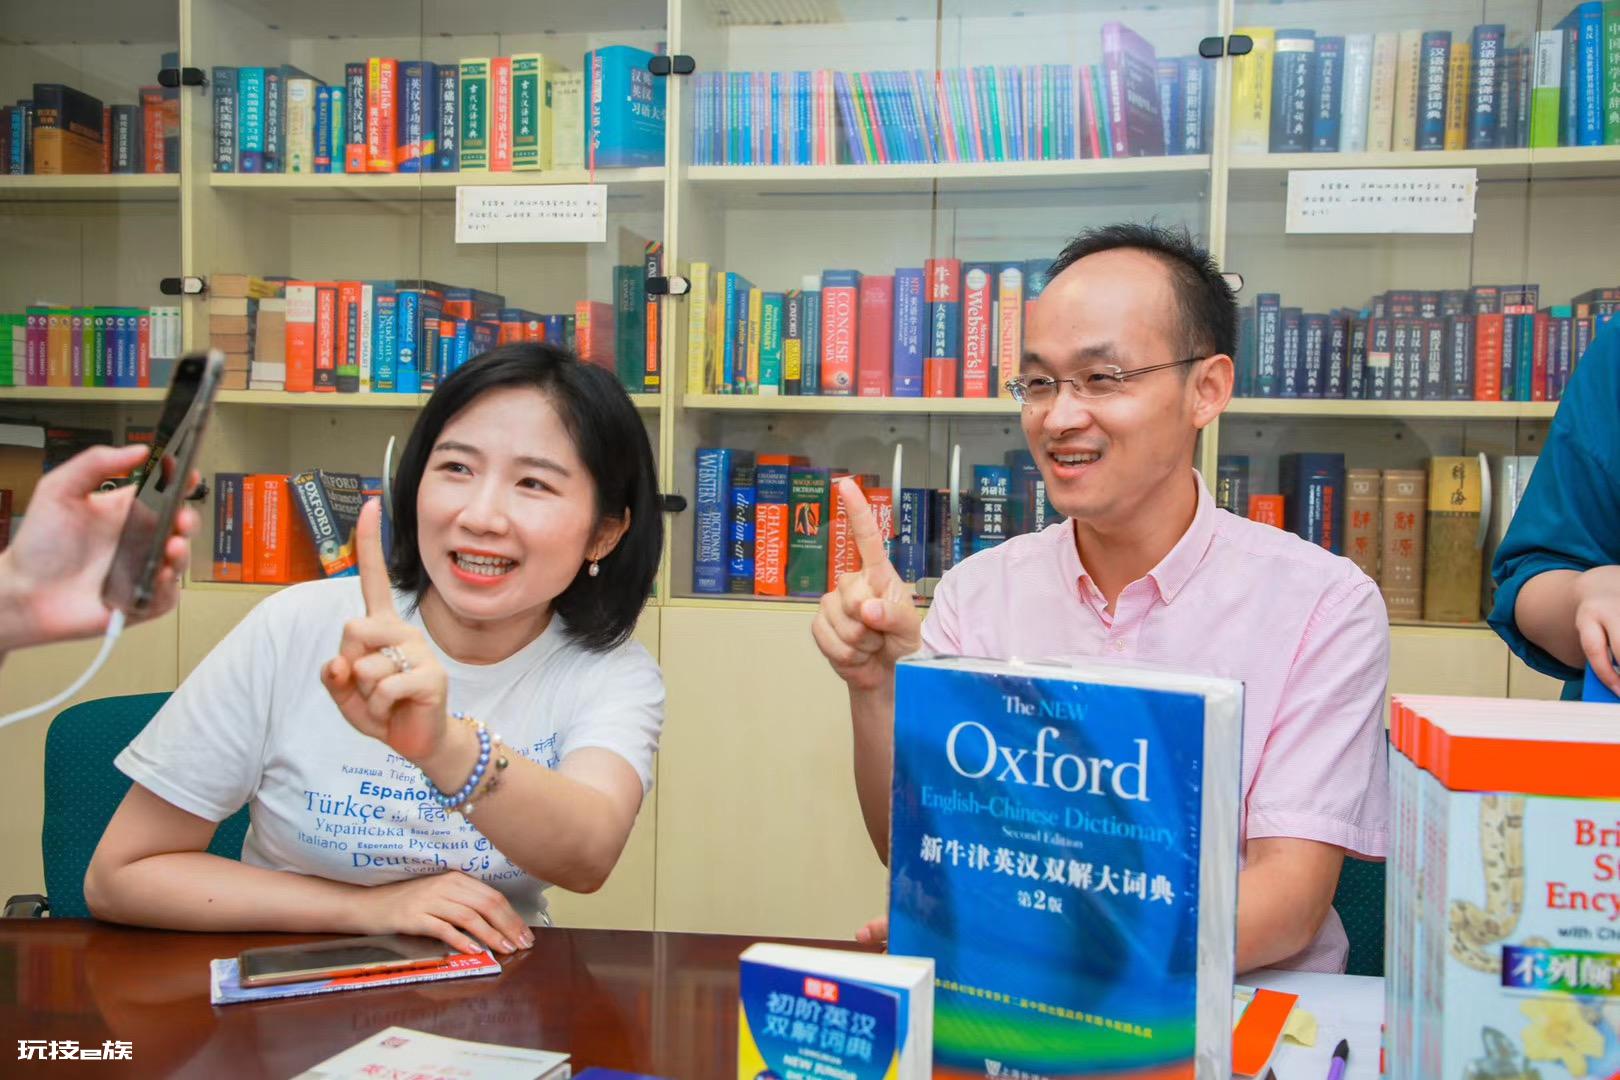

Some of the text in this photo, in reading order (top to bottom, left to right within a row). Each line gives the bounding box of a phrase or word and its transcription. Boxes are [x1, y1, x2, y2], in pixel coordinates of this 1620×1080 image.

[1293, 53, 1307, 135] 汉英多功能词典
[1427, 47, 1445, 119] 汉语熟语英译词典
[1476, 40, 1496, 113] 汉语熟语英译词典
[410, 78, 421, 156] 英汉多功能词典
[443, 78, 454, 150] 基础英汉词典
[468, 83, 479, 138] 古代汉语词典
[520, 80, 530, 135] 古代汉语词典
[934, 266, 950, 299] 牛津
[385, 315, 396, 362] Student's
[406, 295, 414, 342] CAMBRIDGE
[764, 304, 773, 351] DICTIONARY
[789, 302, 797, 337] OXFORD
[826, 292, 836, 361] DICTIONARY
[836, 292, 849, 363] CONCISE
[935, 303, 946, 357] 大学英语词典
[967, 290, 984, 369] Webster's
[1002, 295, 1018, 379] Thesaurus
[698, 454, 718, 503] WEBSTER'S
[980, 486, 1007, 496] 外研社
[304, 481, 333, 536] OXFORD
[901, 492, 912, 544] 英华大词典
[984, 503, 1002, 513] 英汉
[984, 513, 1002, 523] 汉英
[984, 523, 1001, 533] 词典
[701, 513, 711, 562] THESAURUS
[711, 512, 721, 562] DICTIONARY
[755, 505, 767, 583] DICTIONARY
[766, 505, 780, 584] CHAMBERS
[1003, 696, 1088, 721] The NEW
[946, 721, 1151, 802] Oxford
[304, 790, 386, 823] Türkçe
[314, 818, 404, 838] Українська
[1065, 808, 1178, 850] Dictionary
[297, 831, 348, 850] Italiano
[352, 852, 448, 870] Deutsch
[357, 842, 404, 851] Esperanto
[409, 838, 469, 852] Русский
[1002, 826, 1083, 849] Second Edition
[920, 834, 1175, 905] 新牛津英汉双解大词典
[1018, 890, 1063, 914] 第2版
[1558, 928, 1592, 938] with
[762, 1014, 873, 1063] 双解词典
[766, 992, 876, 1040] 初阶英汉
